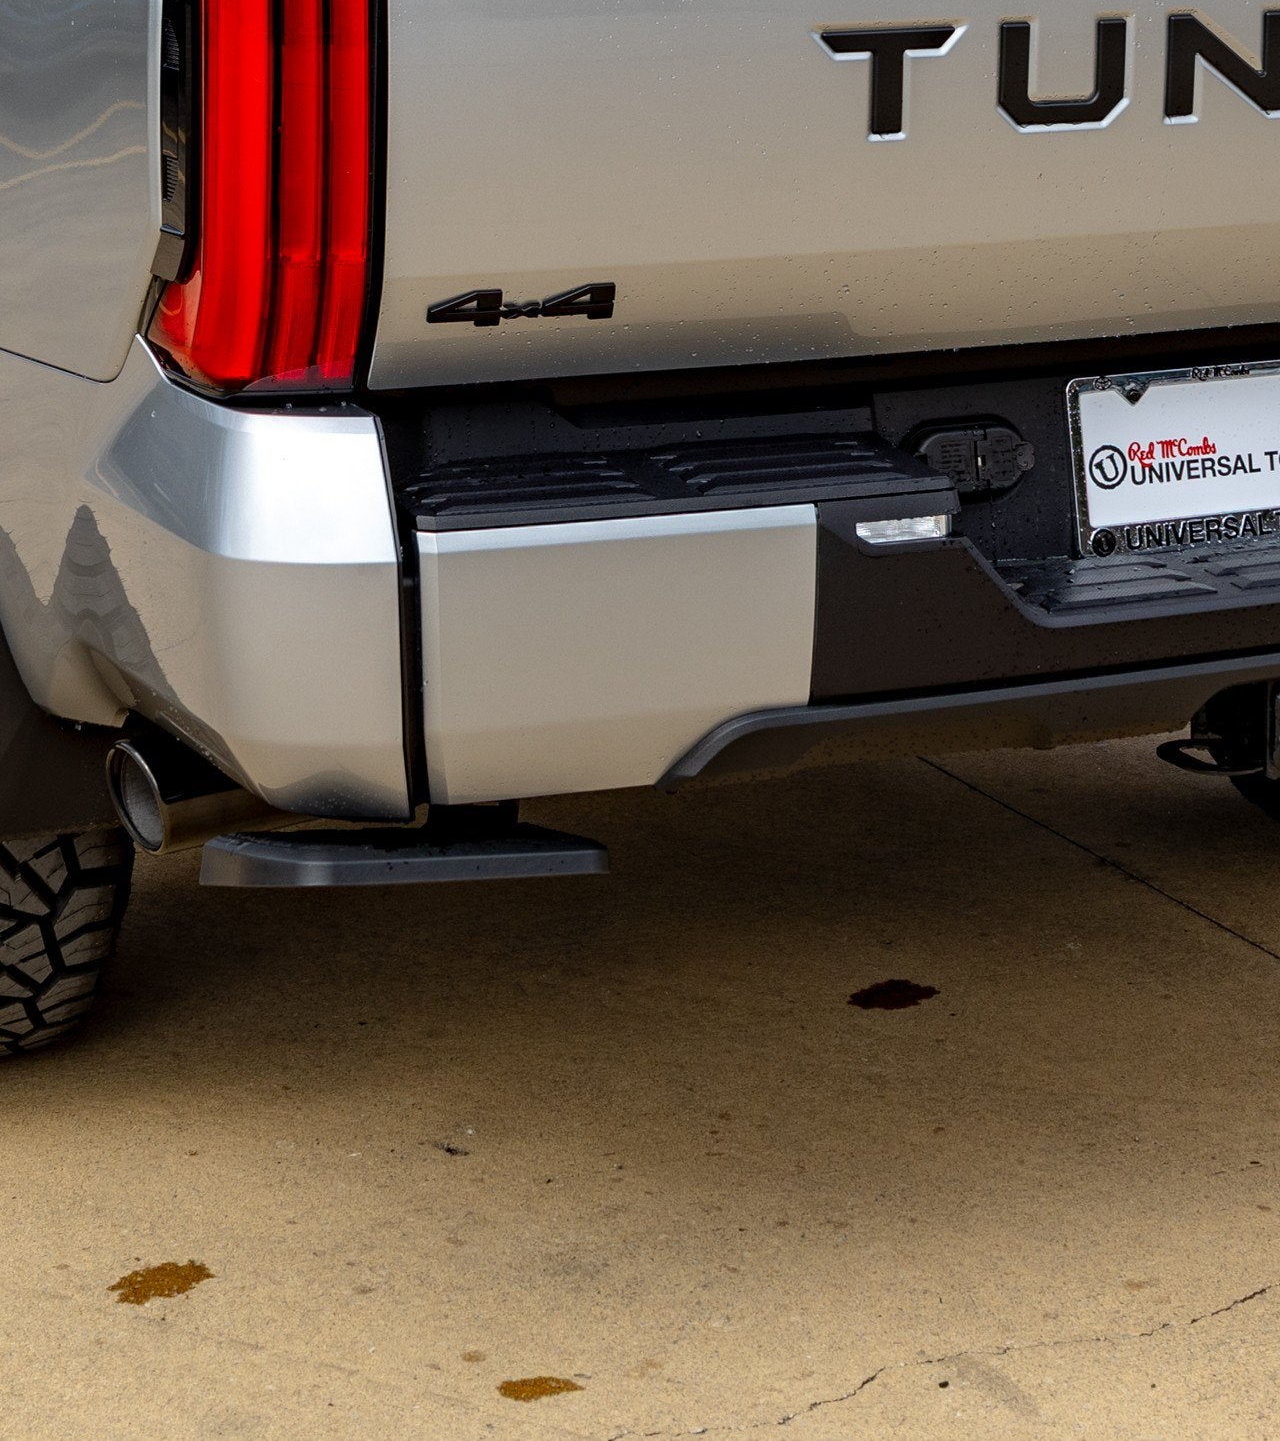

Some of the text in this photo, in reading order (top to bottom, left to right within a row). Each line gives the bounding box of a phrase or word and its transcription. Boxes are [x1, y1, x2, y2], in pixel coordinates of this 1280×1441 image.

[1128, 436, 1217, 468] Red McCombs
[1130, 452, 1261, 486] UNIVERSAL
[1124, 512, 1273, 550] UNIVERSAL
